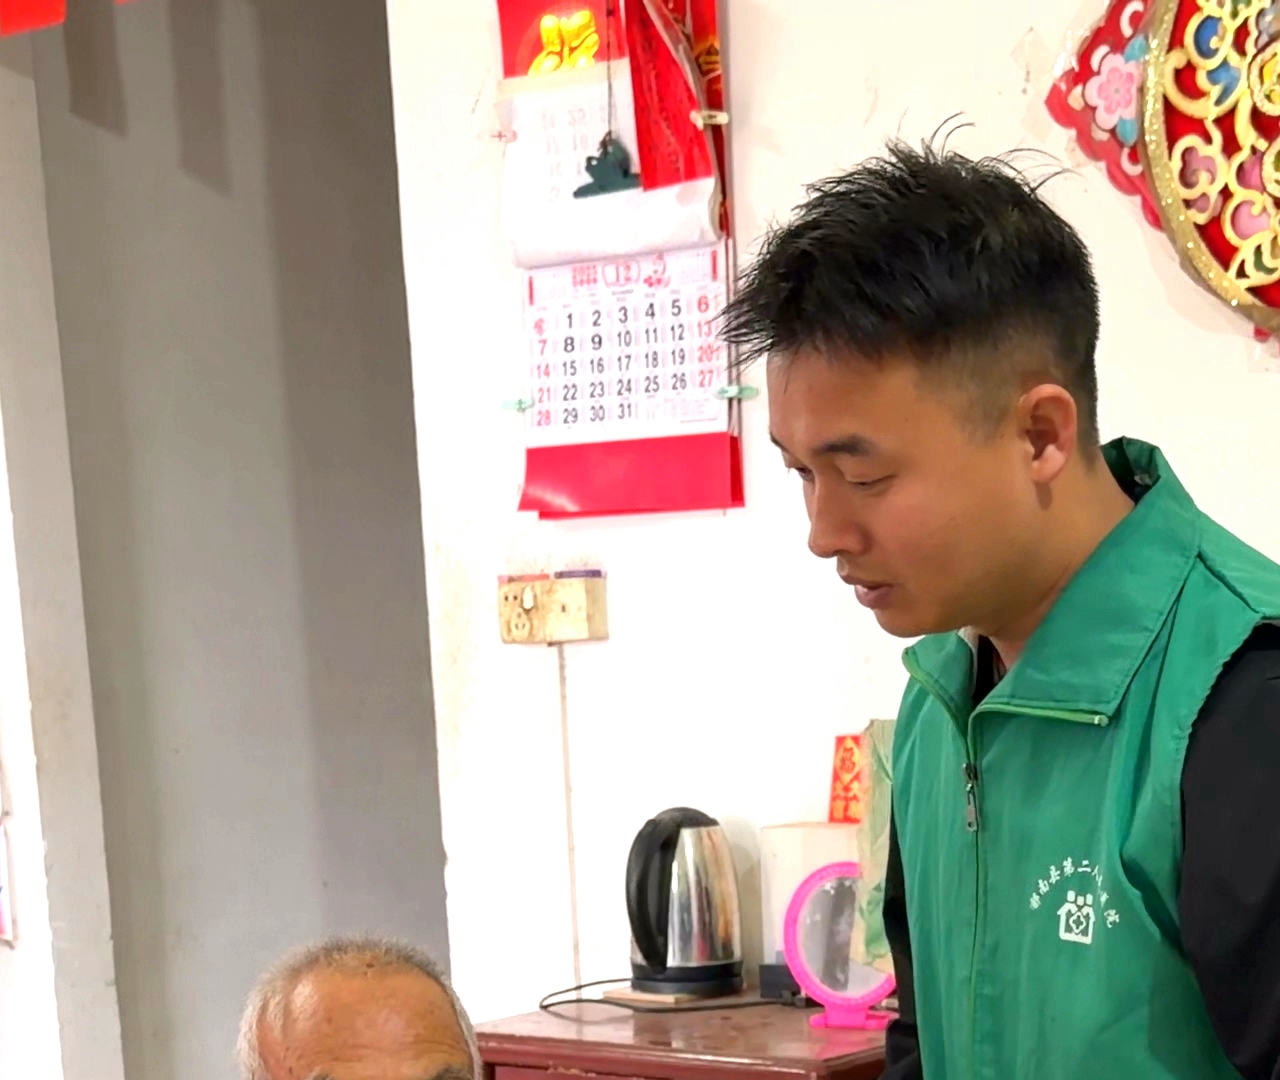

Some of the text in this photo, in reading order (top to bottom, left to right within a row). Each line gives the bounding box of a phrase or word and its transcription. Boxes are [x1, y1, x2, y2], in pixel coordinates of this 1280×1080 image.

[567, 296, 709, 328] 1 2 3 4 5 6
[538, 321, 712, 356] 7 8 9 10 11 12 13
[537, 345, 713, 379] 14 15 16 17 18 19 20
[538, 370, 714, 403] 21 22 23 24 25 26 27
[537, 403, 632, 426] 28 29 30 31
